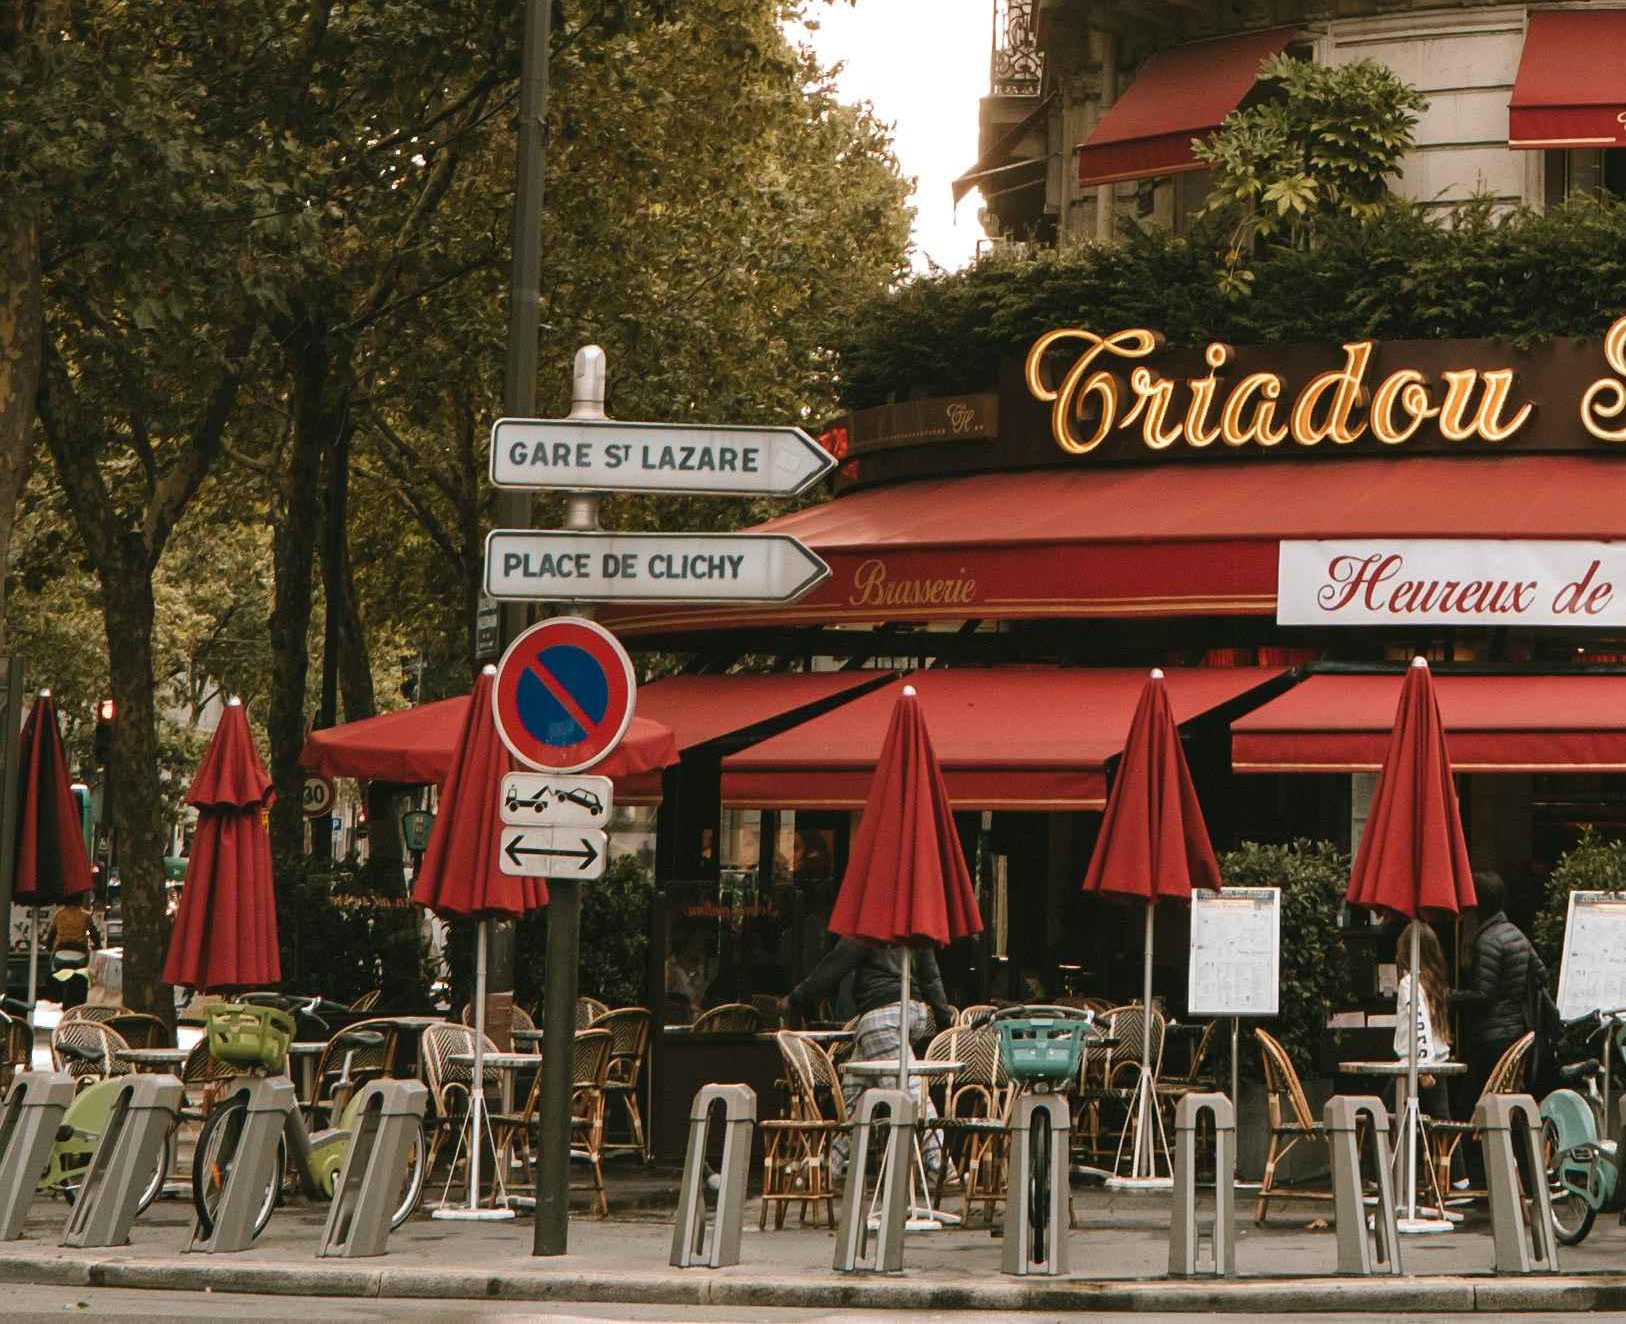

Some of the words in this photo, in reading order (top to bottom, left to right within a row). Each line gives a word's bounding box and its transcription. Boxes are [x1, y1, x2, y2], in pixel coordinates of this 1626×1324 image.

[1025, 328, 1534, 455] Triadou
[508, 441, 593, 468] GARE
[641, 445, 760, 473] LAZARE
[503, 552, 592, 579] PLACE
[601, 553, 638, 579] DE
[647, 554, 745, 580] CLICHY
[849, 558, 977, 606] Brasserie
[1316, 553, 1538, 615] Heureux
[1551, 560, 1614, 616] de
